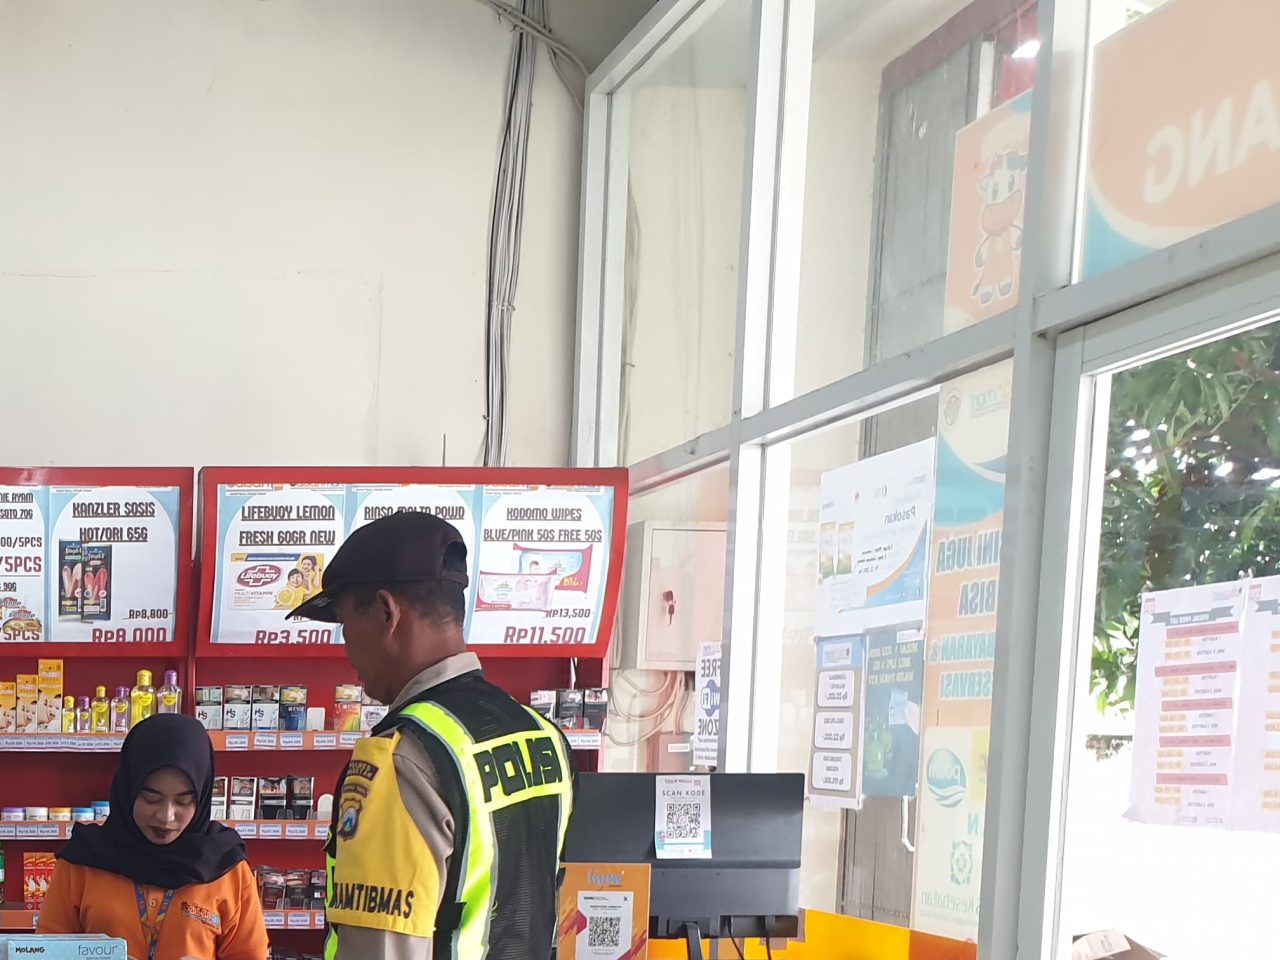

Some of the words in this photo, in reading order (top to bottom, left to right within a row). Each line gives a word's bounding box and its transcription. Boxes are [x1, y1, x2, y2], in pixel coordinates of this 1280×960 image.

[12, 493, 33, 503] AYAM
[73, 502, 120, 517] KANZLER
[124, 502, 155, 517] SOSIS
[241, 506, 292, 520] LIFEBUOY
[297, 506, 335, 520] LEMON
[364, 506, 393, 519] RINSO
[434, 506, 464, 519] POWD
[507, 508, 548, 520] KODOMO
[552, 508, 582, 520] WIPES
[80, 527, 122, 542] HOT/ORI
[127, 527, 148, 542] 65G
[239, 531, 274, 546] FRESH
[278, 531, 306, 546] 60GR
[310, 531, 336, 546] NEW
[483, 529, 534, 541] BLUE/PINK
[537, 529, 555, 541] 50S
[558, 529, 581, 541] FREE
[584, 529, 602, 541] 50S
[78, 944, 118, 956] favour
